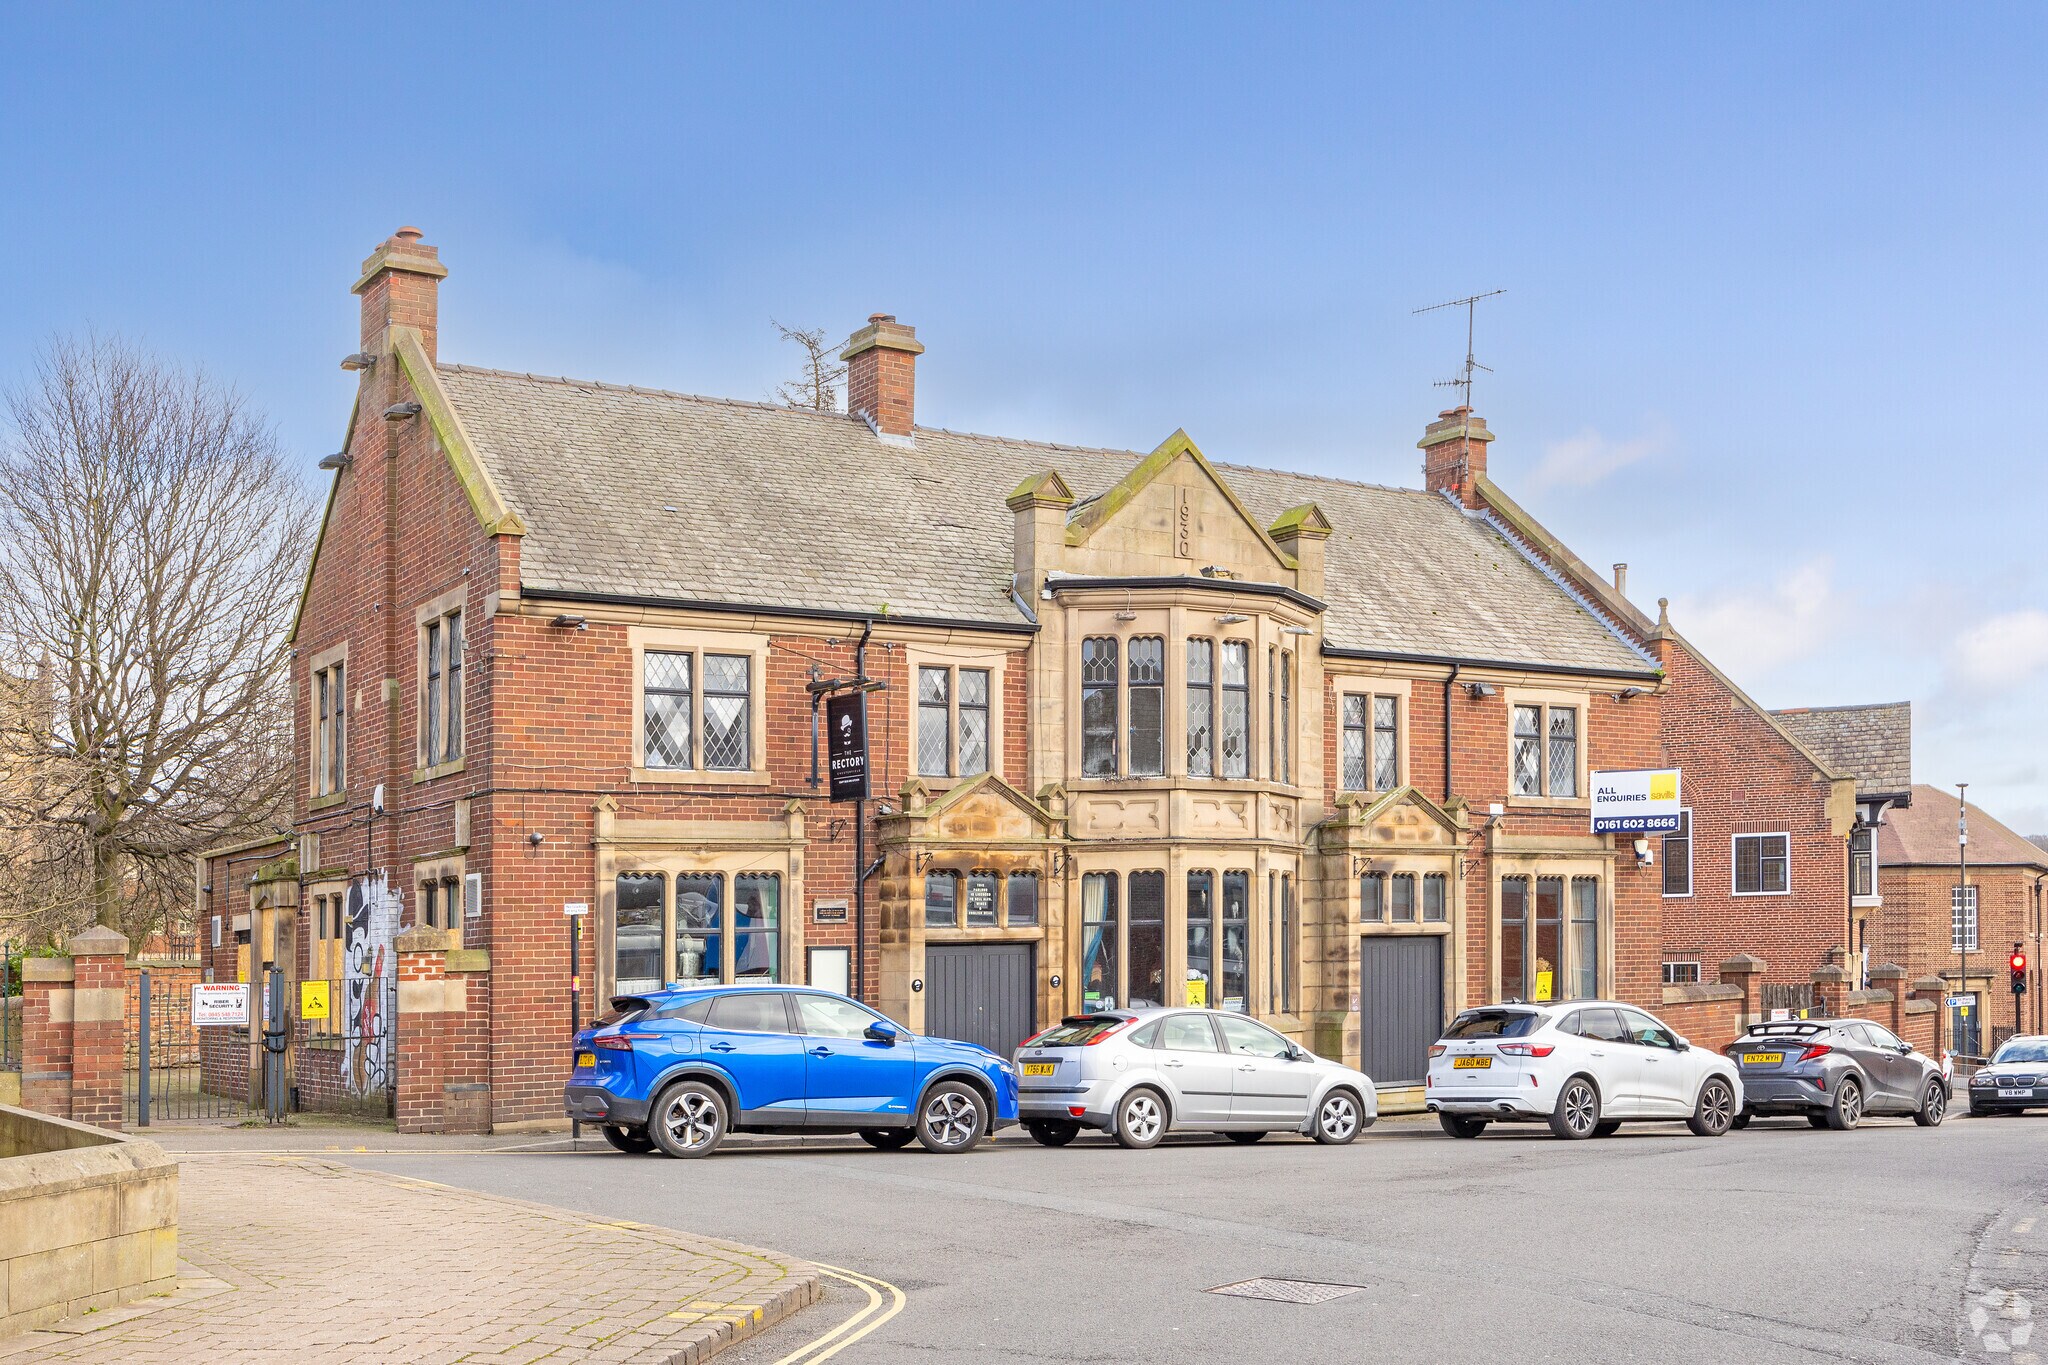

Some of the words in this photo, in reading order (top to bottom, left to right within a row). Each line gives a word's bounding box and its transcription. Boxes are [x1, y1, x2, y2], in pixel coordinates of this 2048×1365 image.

[1180, 489, 1188, 556] 1930
[832, 756, 864, 770] RECTORY
[1598, 787, 1616, 795] ALL
[1651, 790, 1675, 800] savills
[1597, 794, 1647, 802] ENQUIRIES
[1597, 820, 1621, 829] 0161
[1622, 819, 1644, 828] 602
[1647, 818, 1675, 827] 8666
